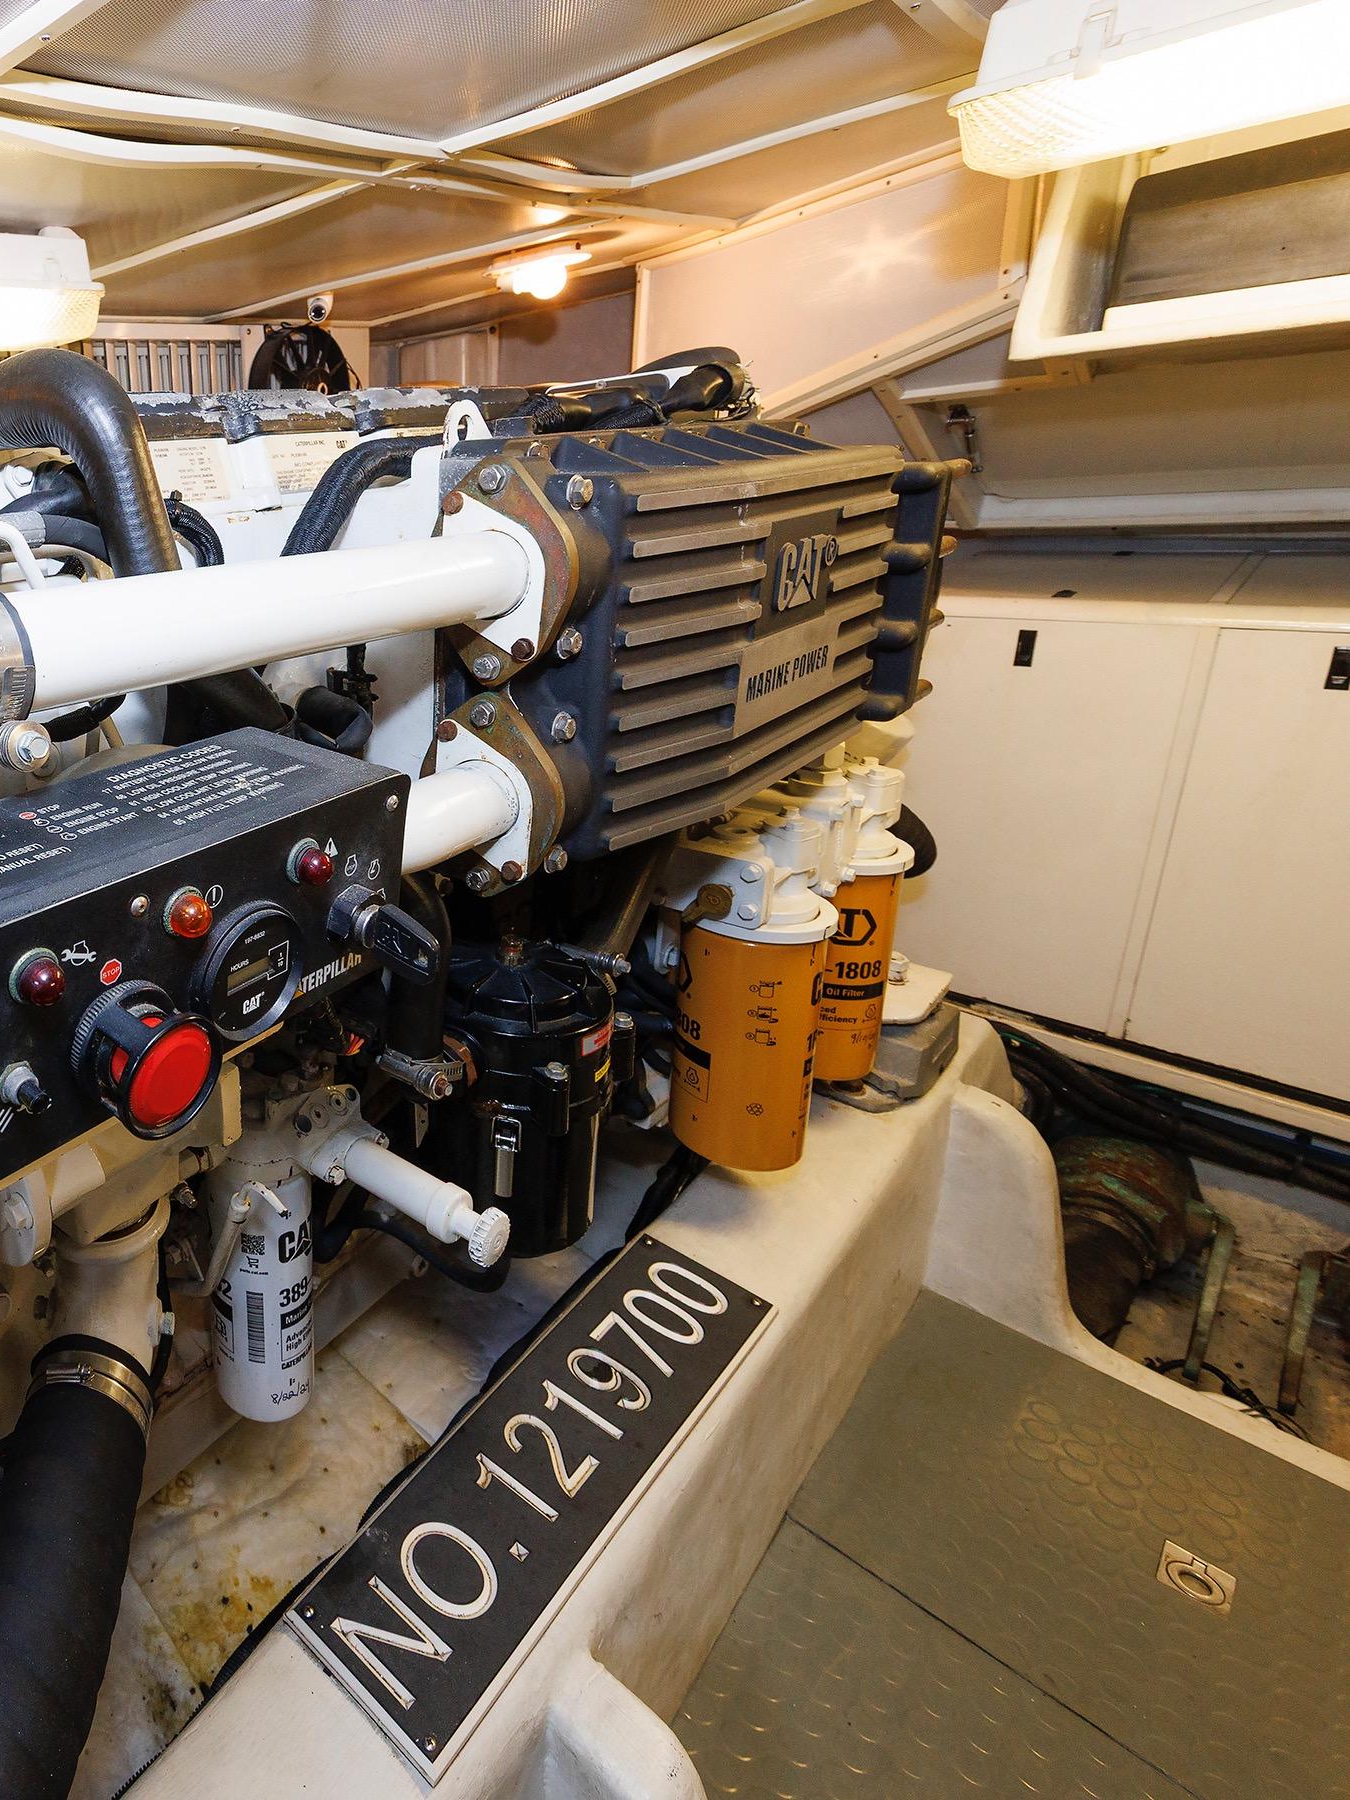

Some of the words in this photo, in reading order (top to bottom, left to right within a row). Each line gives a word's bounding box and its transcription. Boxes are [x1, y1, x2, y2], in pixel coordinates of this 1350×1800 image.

[746, 660, 791, 703] MARINE
[791, 644, 829, 682] POWER
[105, 756, 182, 783] DIAGNOSTIC
[179, 744, 222, 759] CODES
[112, 776, 151, 790] BATTERY
[145, 765, 183, 778] VOLTAGE
[125, 787, 149, 795] LOW
[138, 792, 164, 801] HIGH
[158, 780, 199, 794] COOLANT
[153, 799, 177, 807] LOW
[172, 786, 213, 800] COOLANT
[37, 803, 60, 815] STOP
[50, 808, 85, 821] ENGINE
[83, 802, 103, 812] RUN
[168, 804, 194, 813] HIGH
[188, 794, 222, 806] INTAKE
[183, 811, 210, 820] HIGH
[203, 803, 231, 813] FUEL
[63, 814, 99, 828] ENGINE
[96, 806, 119, 818] STOP
[77, 820, 113, 835] ENGINE
[110, 812, 139, 824] START
[5, 842, 45, 860] RESET)
[34, 845, 73, 863] RESET)
[102, 965, 120, 979] STOP
[230, 958, 250, 973] HOURS
[826, 988, 840, 997] Oil
[842, 989, 866, 998] Filter
[286, 1338, 302, 1352] High
